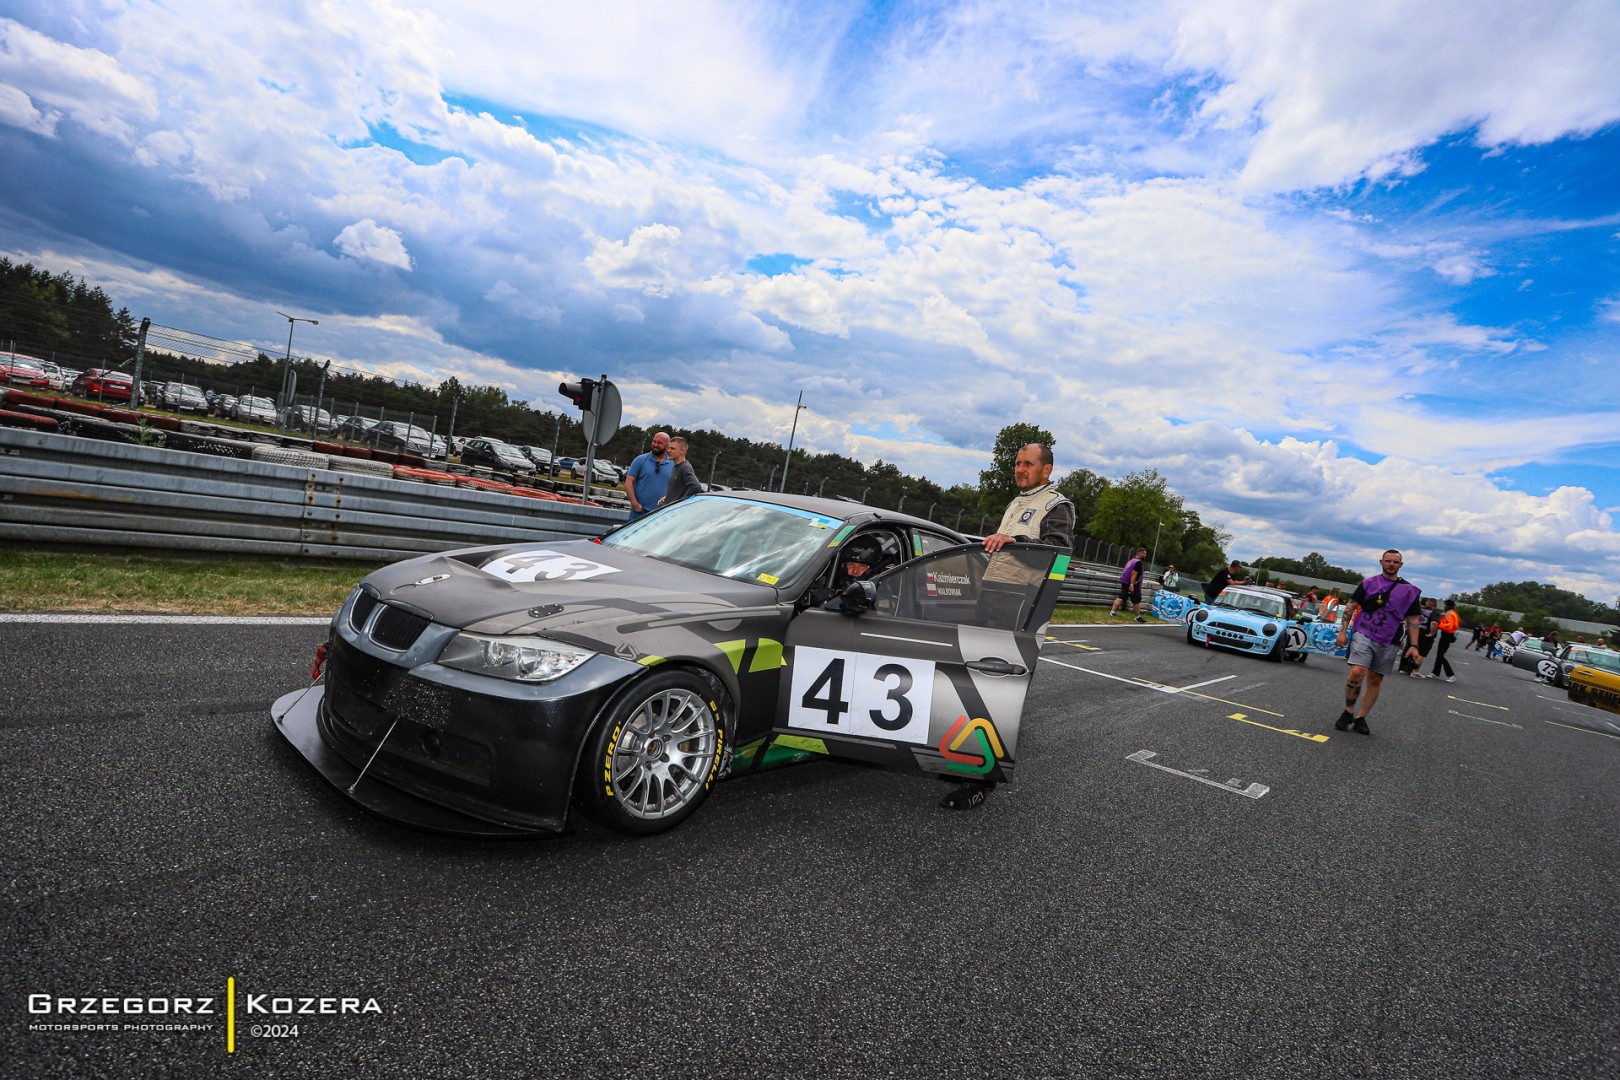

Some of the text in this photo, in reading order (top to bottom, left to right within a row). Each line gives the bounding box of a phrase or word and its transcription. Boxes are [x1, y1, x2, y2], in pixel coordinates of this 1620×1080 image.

[504, 554, 599, 581] 43
[801, 657, 914, 732] 43
[1542, 662, 1557, 676] 73
[604, 725, 621, 783] ZERO
[705, 728, 724, 791] PIRELLI
